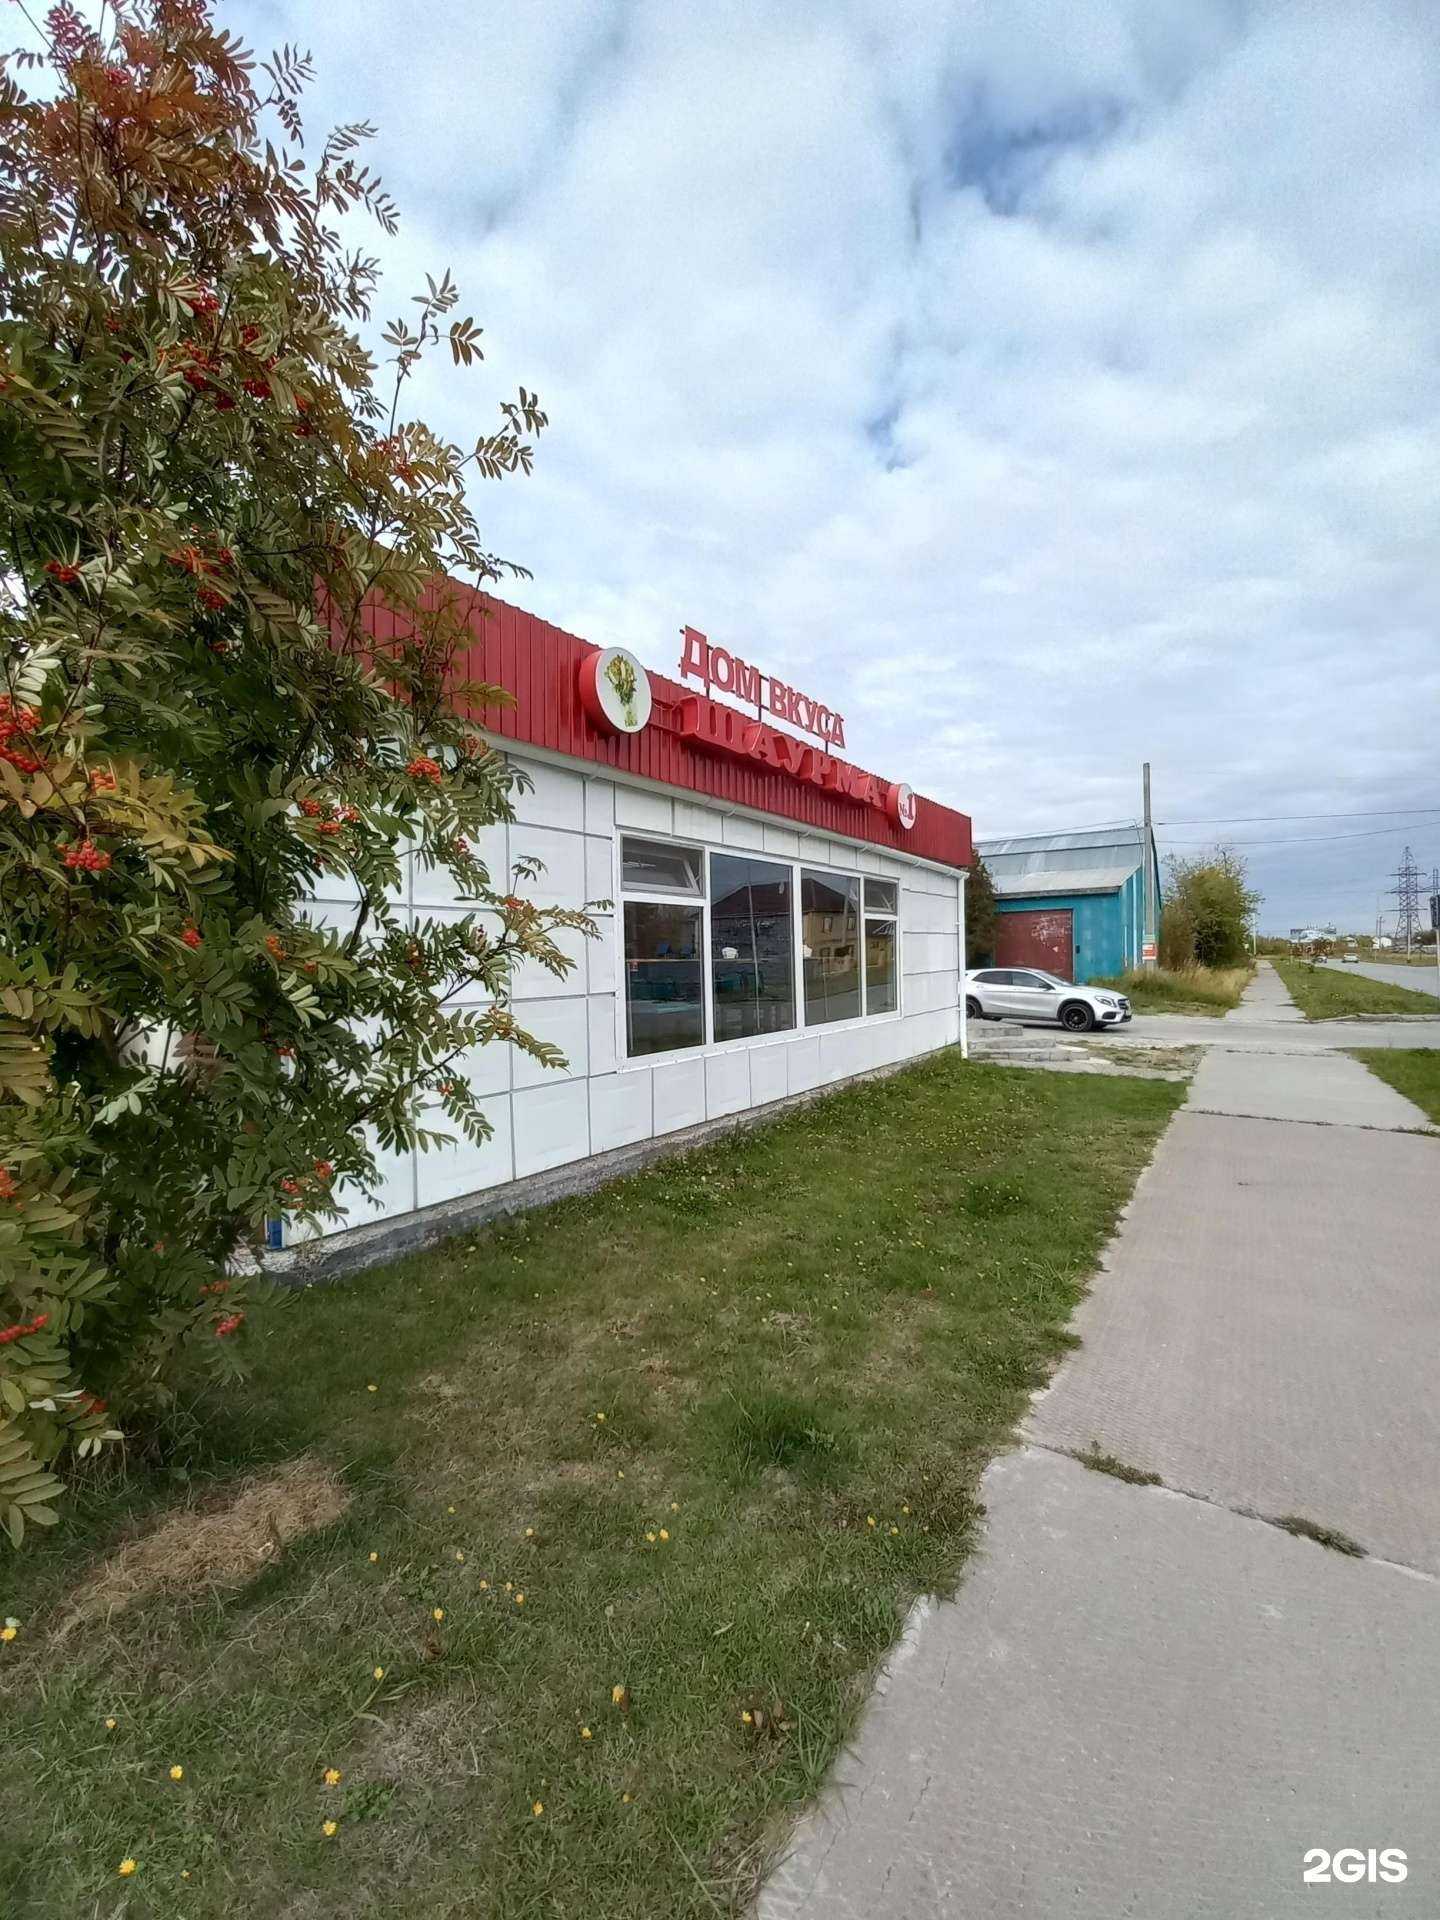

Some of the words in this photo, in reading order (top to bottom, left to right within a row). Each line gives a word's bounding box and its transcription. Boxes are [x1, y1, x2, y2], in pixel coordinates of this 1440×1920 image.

[680, 625, 760, 707] ДОМ
[770, 676, 845, 749] ВКУСА
[683, 694, 882, 807] ШАУРМА
